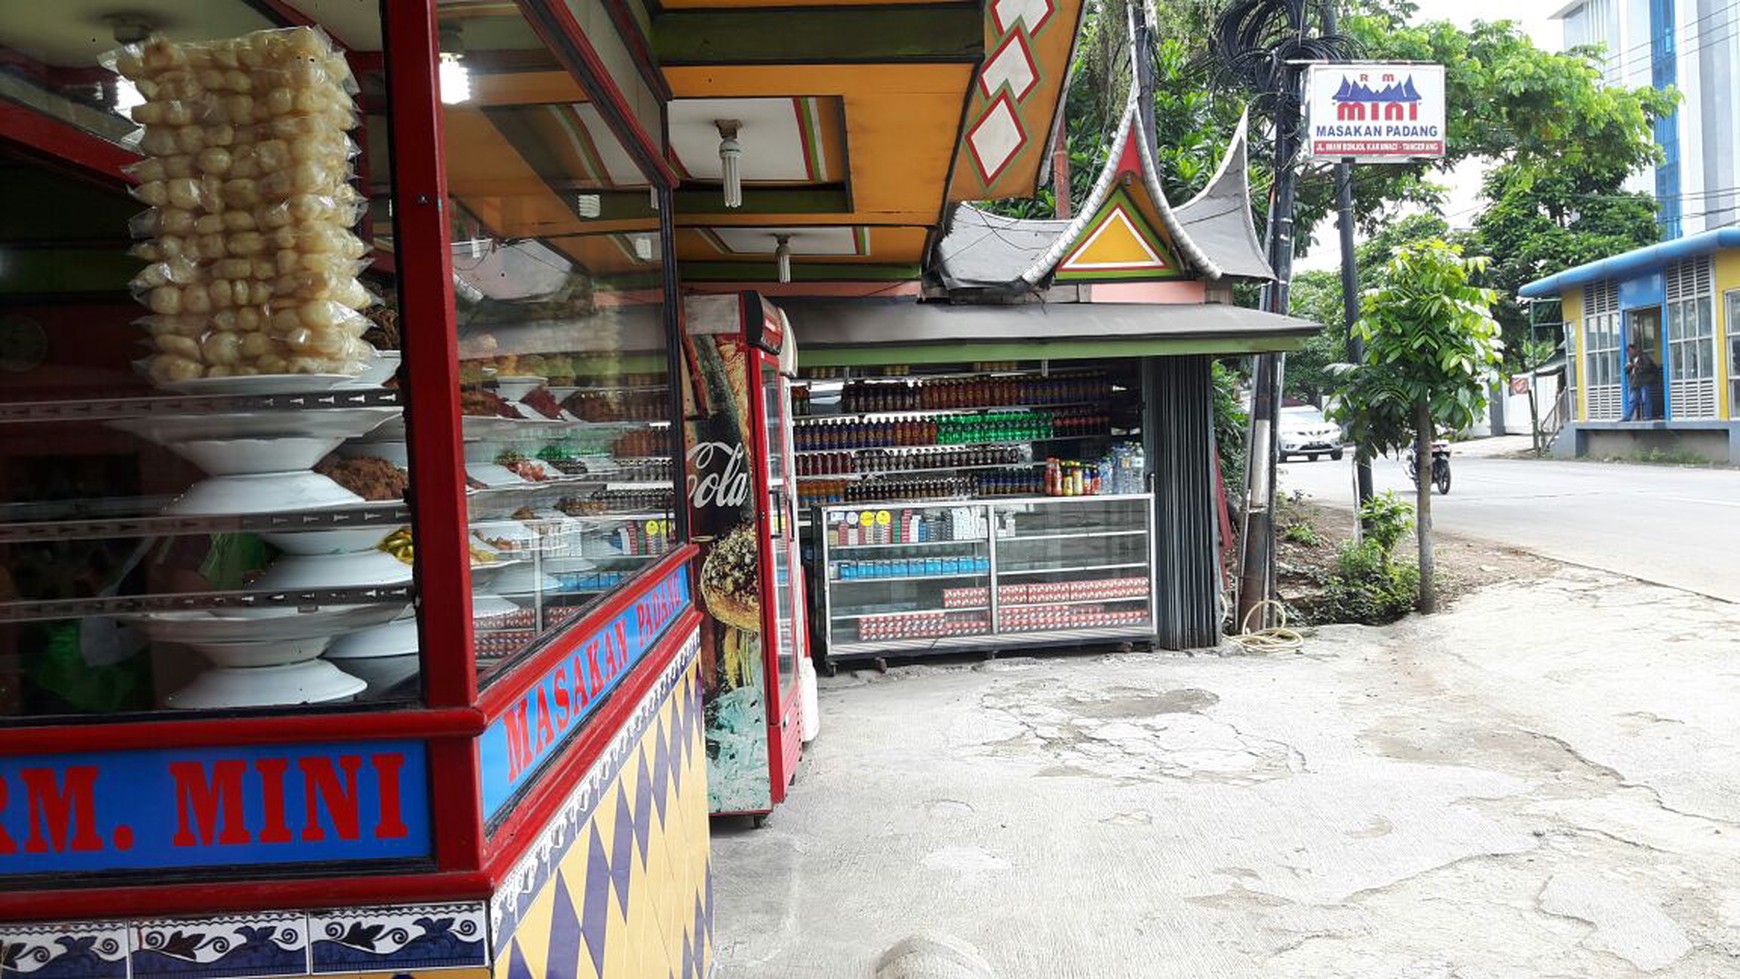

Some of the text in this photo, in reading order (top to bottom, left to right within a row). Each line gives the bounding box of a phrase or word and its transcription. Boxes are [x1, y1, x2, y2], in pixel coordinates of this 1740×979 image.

[1316, 125, 1438, 137] MASAKAN PADANG
[503, 573, 682, 783] MASAKAN PADANG
[169, 752, 408, 847] MINI
